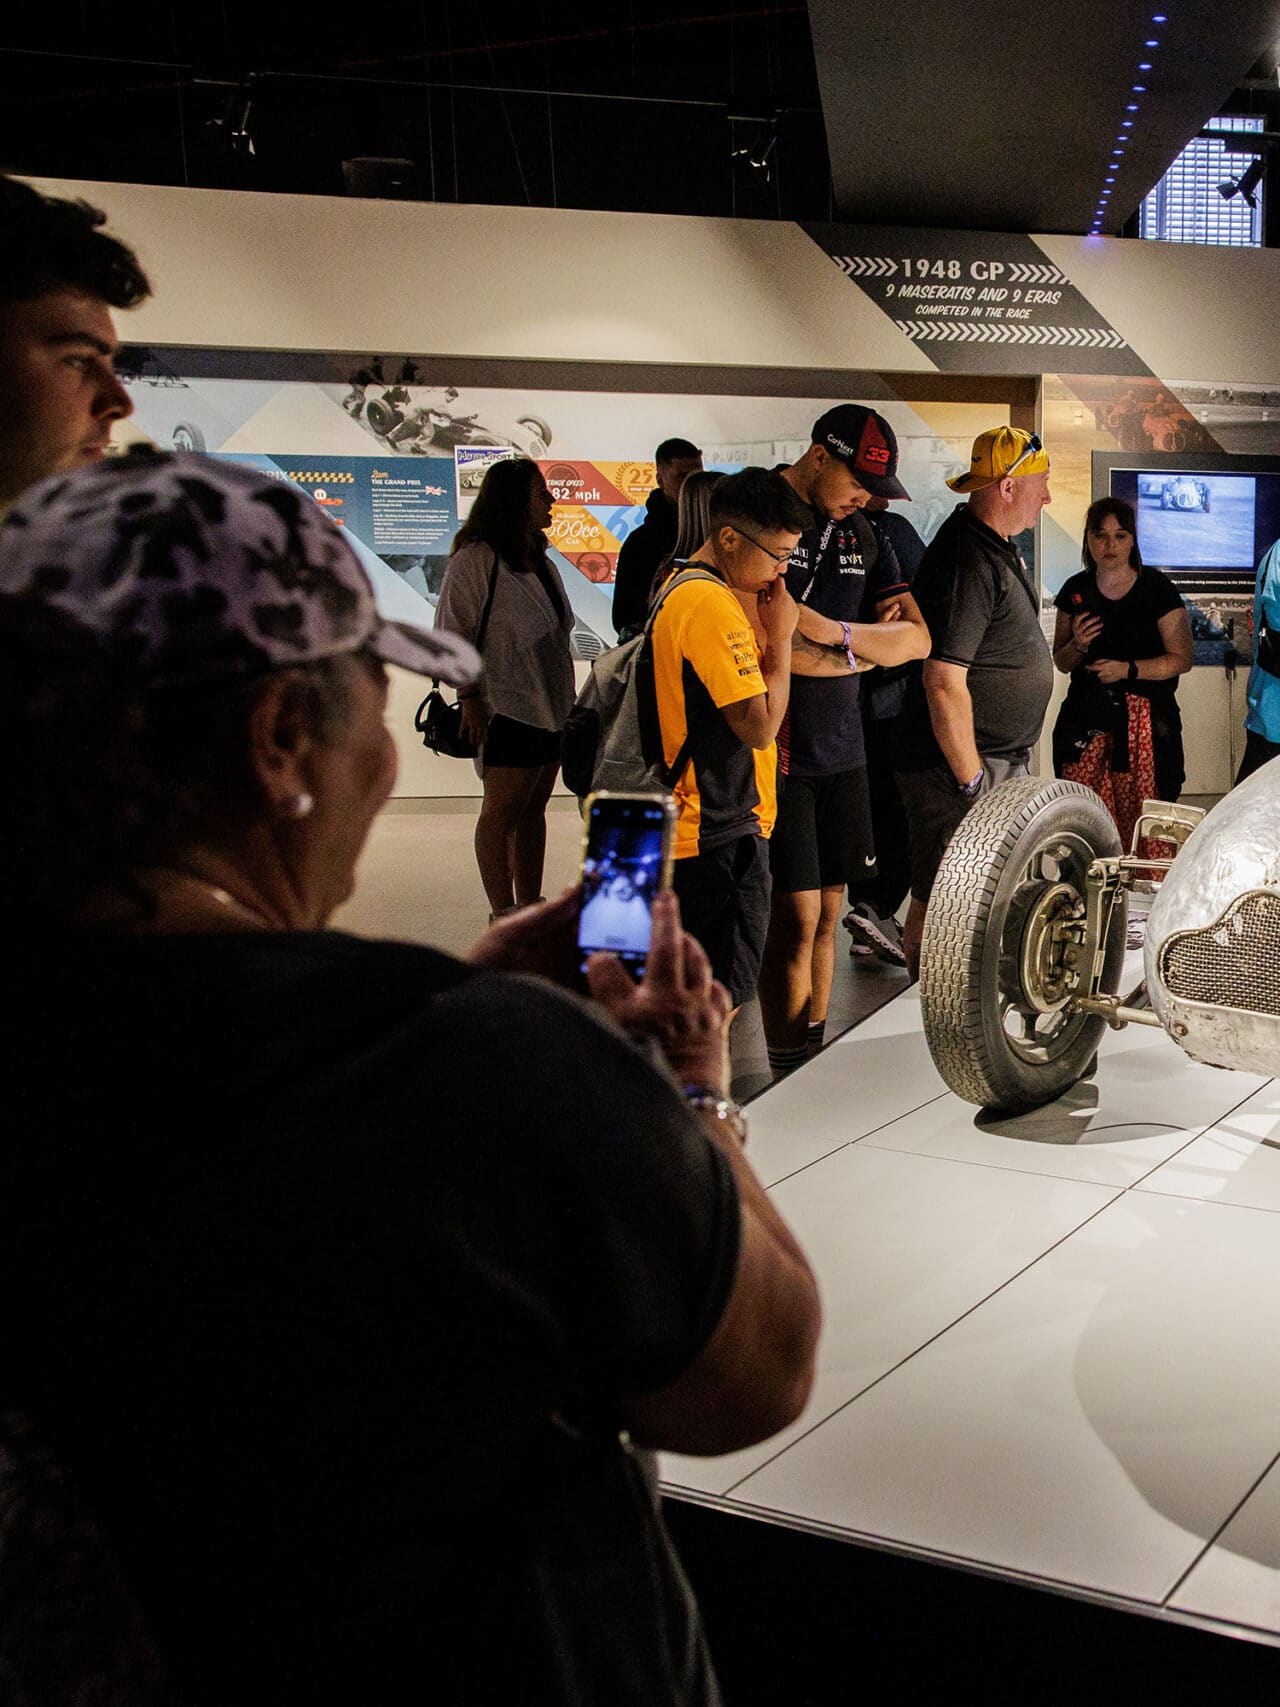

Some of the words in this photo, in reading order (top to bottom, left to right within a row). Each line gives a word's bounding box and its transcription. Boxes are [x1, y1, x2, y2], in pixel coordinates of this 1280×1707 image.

[901, 259, 961, 279] 1948
[970, 261, 1005, 281] GP
[885, 284, 895, 297] 9
[898, 285, 976, 302] MASERATIS
[978, 288, 1007, 303] AND
[1012, 290, 1022, 303] 9
[1024, 290, 1062, 305] ERAS
[915, 304, 969, 317] COMPETED
[971, 307, 983, 317] IN
[984, 307, 1004, 318] THE
[1005, 308, 1032, 319] RACE
[865, 446, 890, 463] 33
[630, 468, 653, 484] 25
